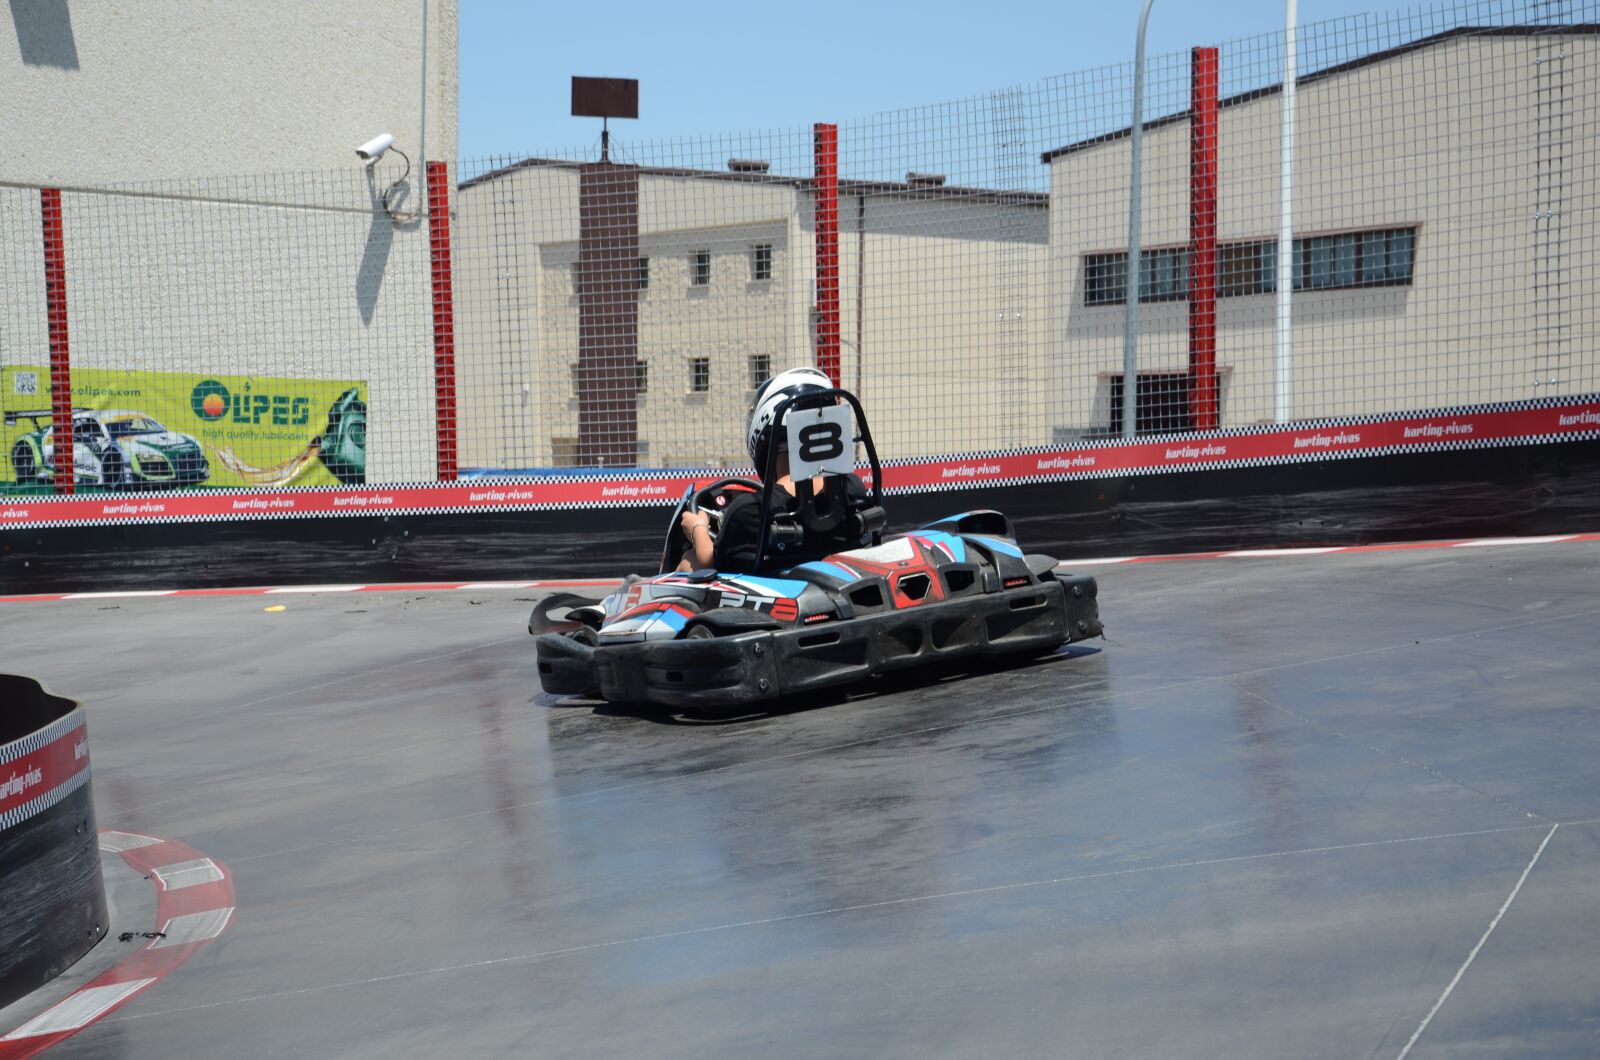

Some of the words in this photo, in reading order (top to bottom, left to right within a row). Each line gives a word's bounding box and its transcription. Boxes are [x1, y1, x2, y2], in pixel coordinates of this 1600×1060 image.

[1403, 421, 1474, 437] karting-rivas
[798, 422, 844, 463] 8
[1293, 430, 1361, 448] karting-rivas
[1165, 443, 1228, 459] karting-rivas
[1037, 454, 1096, 470] karting-rivas
[942, 463, 1001, 478] karting-rivas
[469, 488, 534, 502] karting-rivas
[602, 483, 667, 497] karting-rivas
[102, 502, 165, 514] karting-rivas
[232, 497, 295, 510] karting-rivas
[333, 494, 394, 507] karting-rivas
